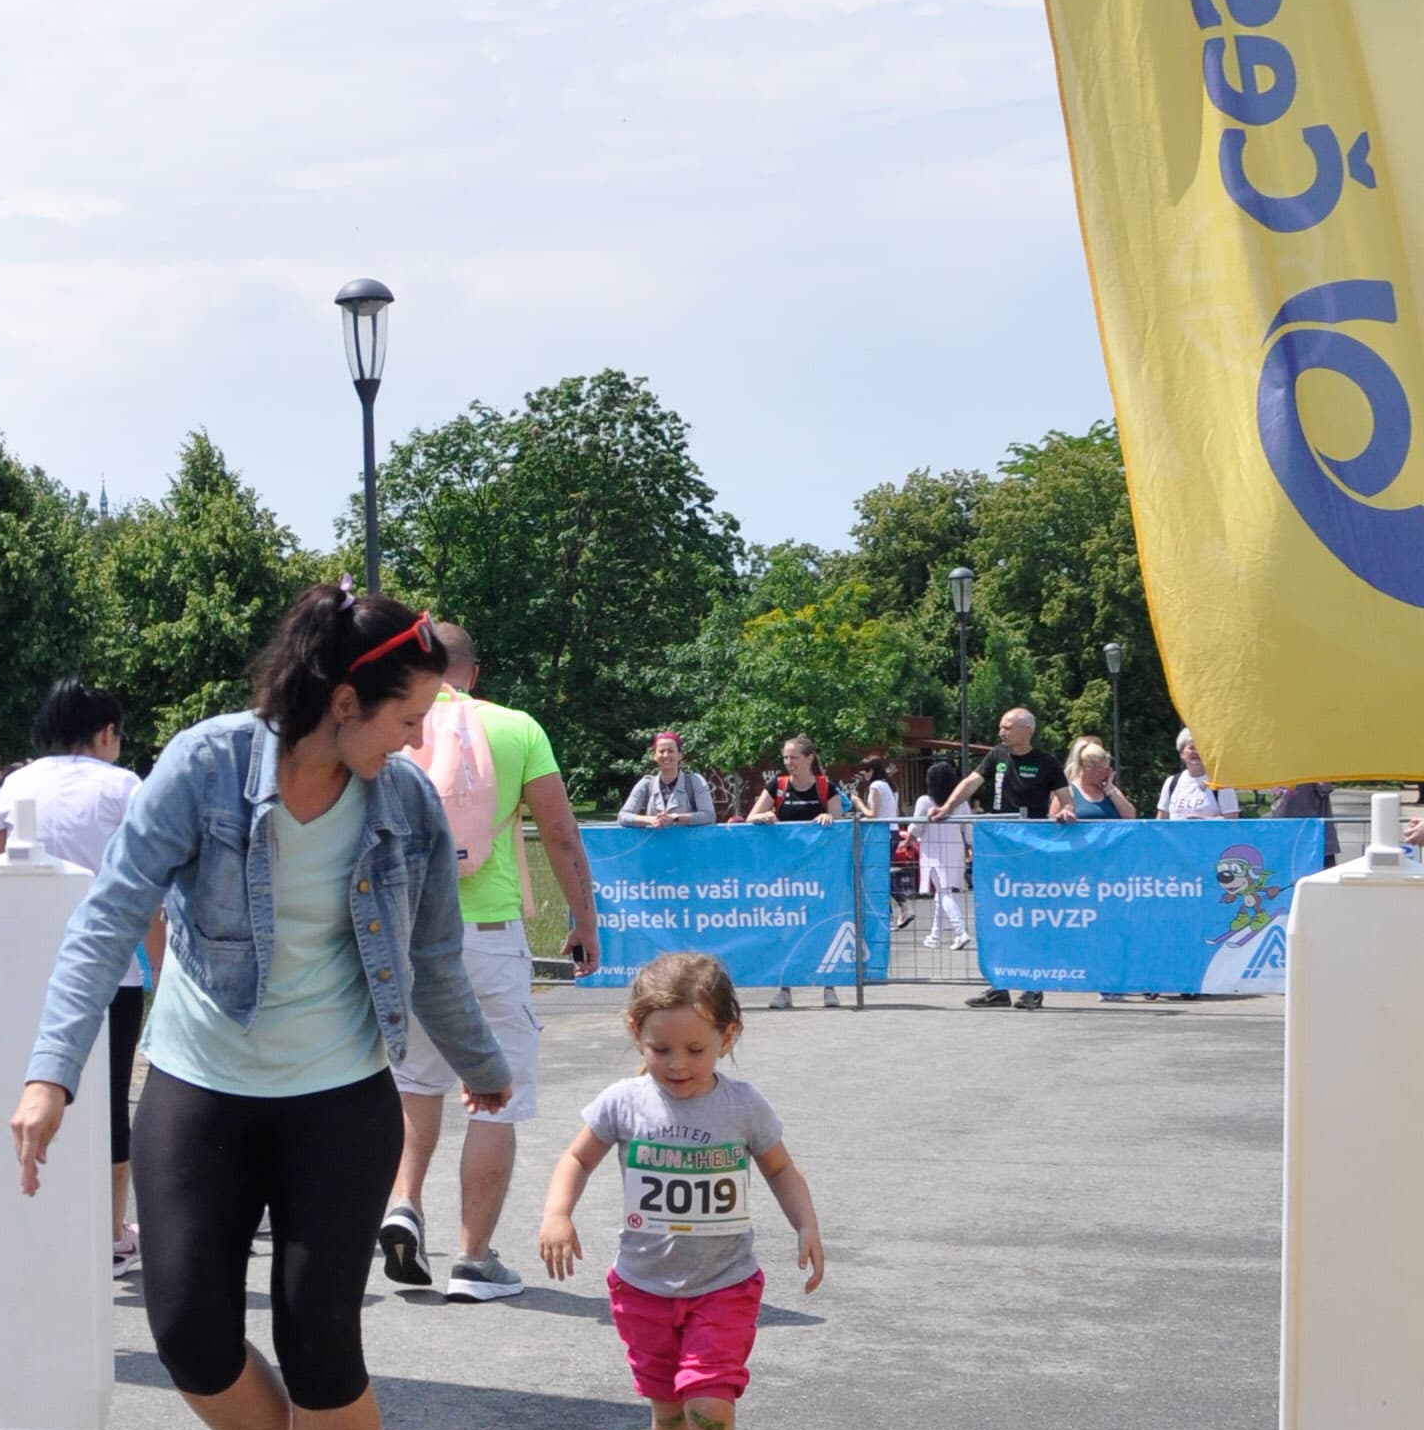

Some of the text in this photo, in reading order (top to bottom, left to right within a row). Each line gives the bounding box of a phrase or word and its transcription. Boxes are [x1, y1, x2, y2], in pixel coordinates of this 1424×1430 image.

[695, 878, 739, 899] vaši
[746, 877, 825, 899] rodinu,
[993, 873, 1203, 902] Úrazové pojištění
[683, 908, 690, 928] i
[696, 906, 807, 932] podnikání
[994, 908, 1097, 929] od PVZP
[994, 966, 1086, 980] www.pvzp.cz
[647, 1124, 712, 1144] LIMITED
[636, 1145, 682, 1168] RUN
[695, 1147, 743, 1170] HELP
[639, 1176, 737, 1214] 2019
